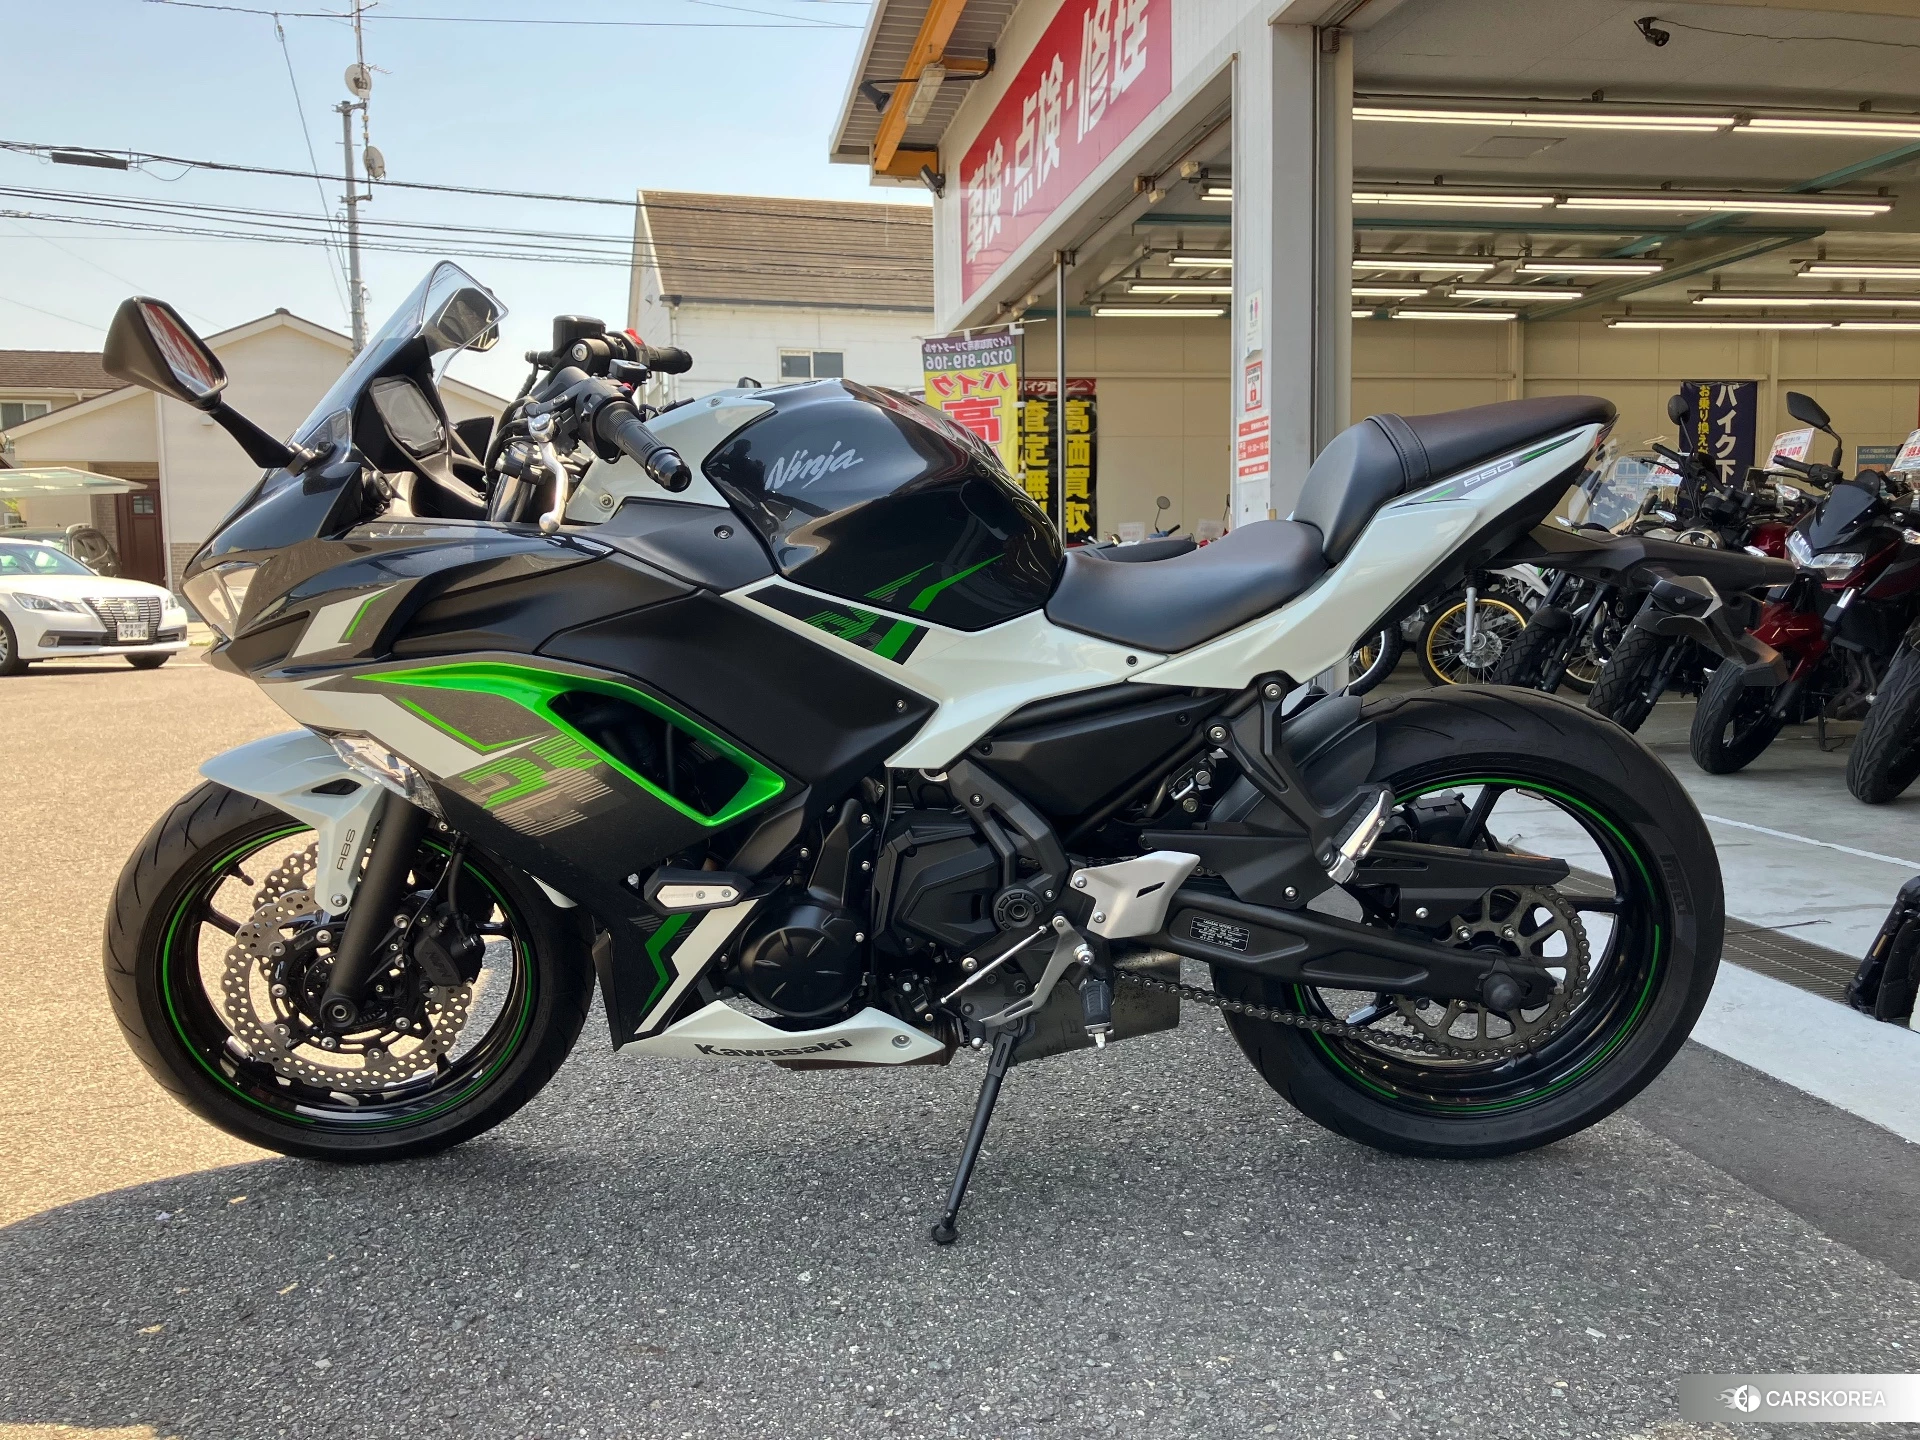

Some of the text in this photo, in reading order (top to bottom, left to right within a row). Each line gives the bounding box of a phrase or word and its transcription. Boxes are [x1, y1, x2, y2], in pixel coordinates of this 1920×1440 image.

[764, 440, 864, 491] Ninja
[1024, 400, 1050, 516] 査定無
[1065, 400, 1091, 534] 高価買取
[1463, 460, 1515, 488] 650
[336, 828, 356, 871] ABS
[694, 1038, 853, 1057] Kawasaki
